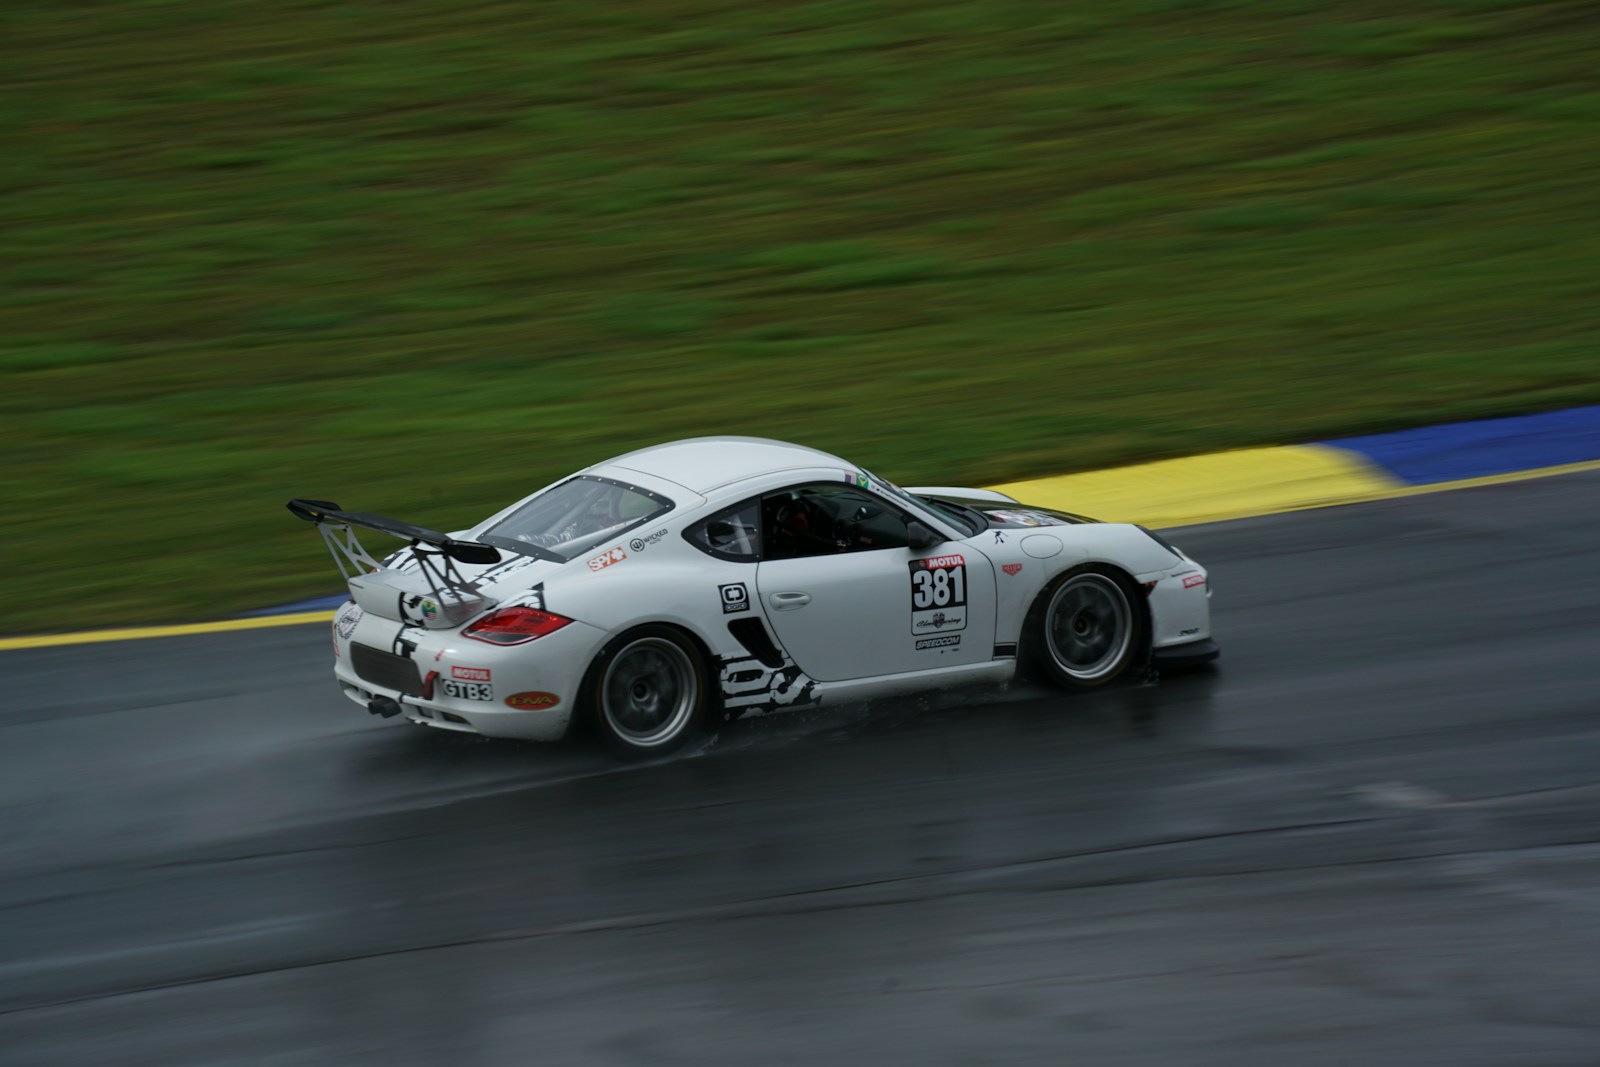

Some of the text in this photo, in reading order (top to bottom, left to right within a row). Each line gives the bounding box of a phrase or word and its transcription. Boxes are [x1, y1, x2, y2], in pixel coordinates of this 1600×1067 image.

[643, 528, 668, 543] WICKED
[588, 551, 613, 571] SPY
[929, 556, 963, 567] MOTUL
[913, 565, 964, 608] 381
[916, 636, 960, 649] SPEEDCOM
[453, 668, 489, 680] MOTUL
[444, 680, 492, 701] GTB3
[511, 696, 553, 705] DVA
